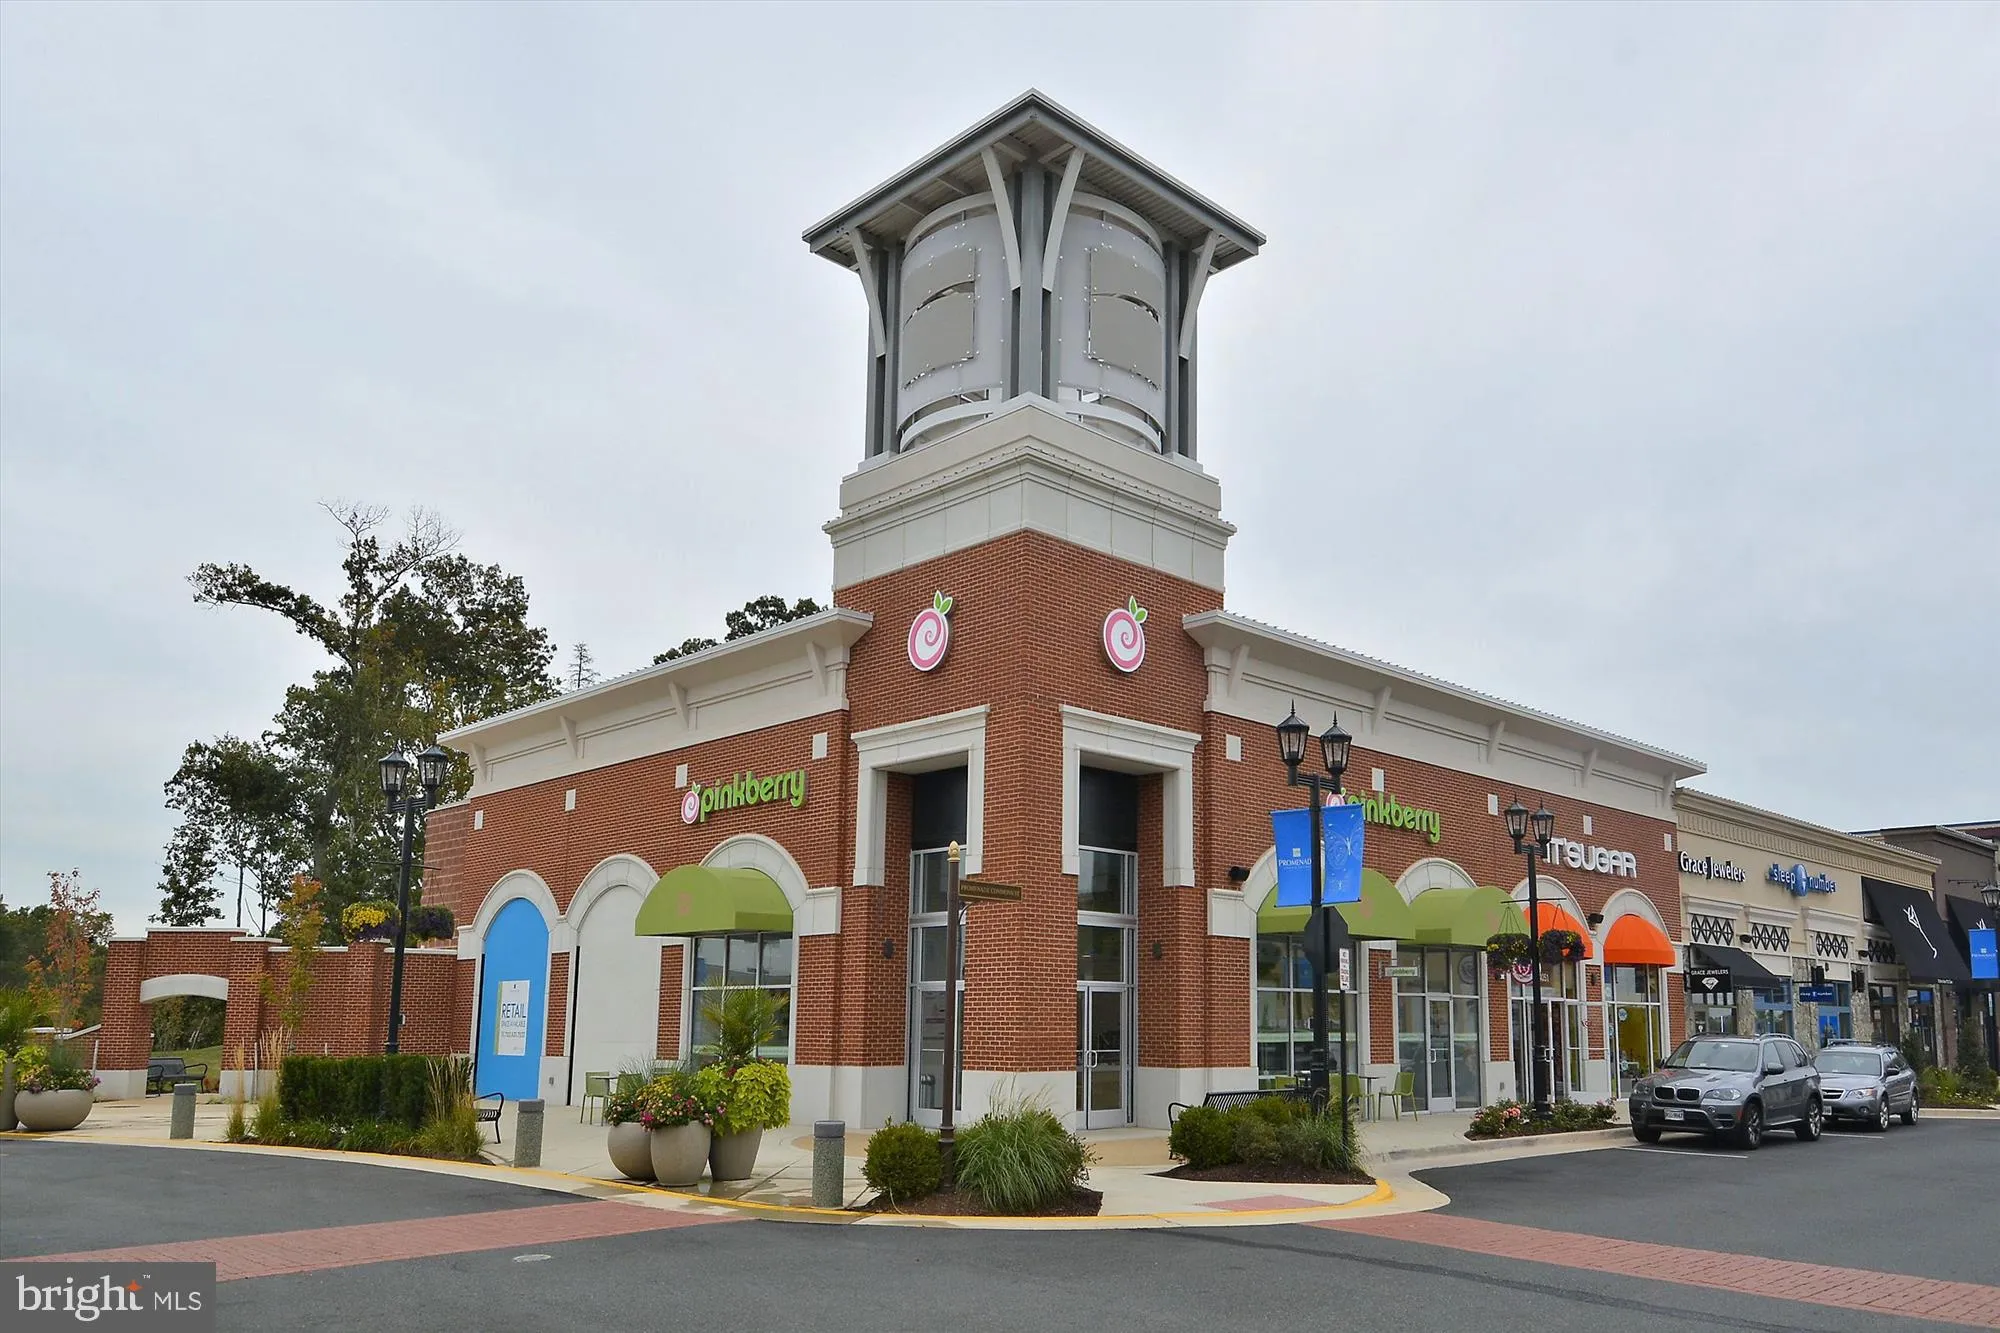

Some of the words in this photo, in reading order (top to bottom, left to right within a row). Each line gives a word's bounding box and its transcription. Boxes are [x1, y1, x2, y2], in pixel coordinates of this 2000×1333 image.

[700, 768, 805, 822] pinkberry
[1278, 858, 1312, 868] PROMENAD
[1680, 850, 1708, 875] Grace
[1710, 856, 1746, 882] Jewelers
[1772, 867, 1796, 890] sleep
[1808, 873, 1837, 893] number
[1706, 968, 1729, 976] JEWELERS
[502, 1003, 527, 1018] RETAIL
